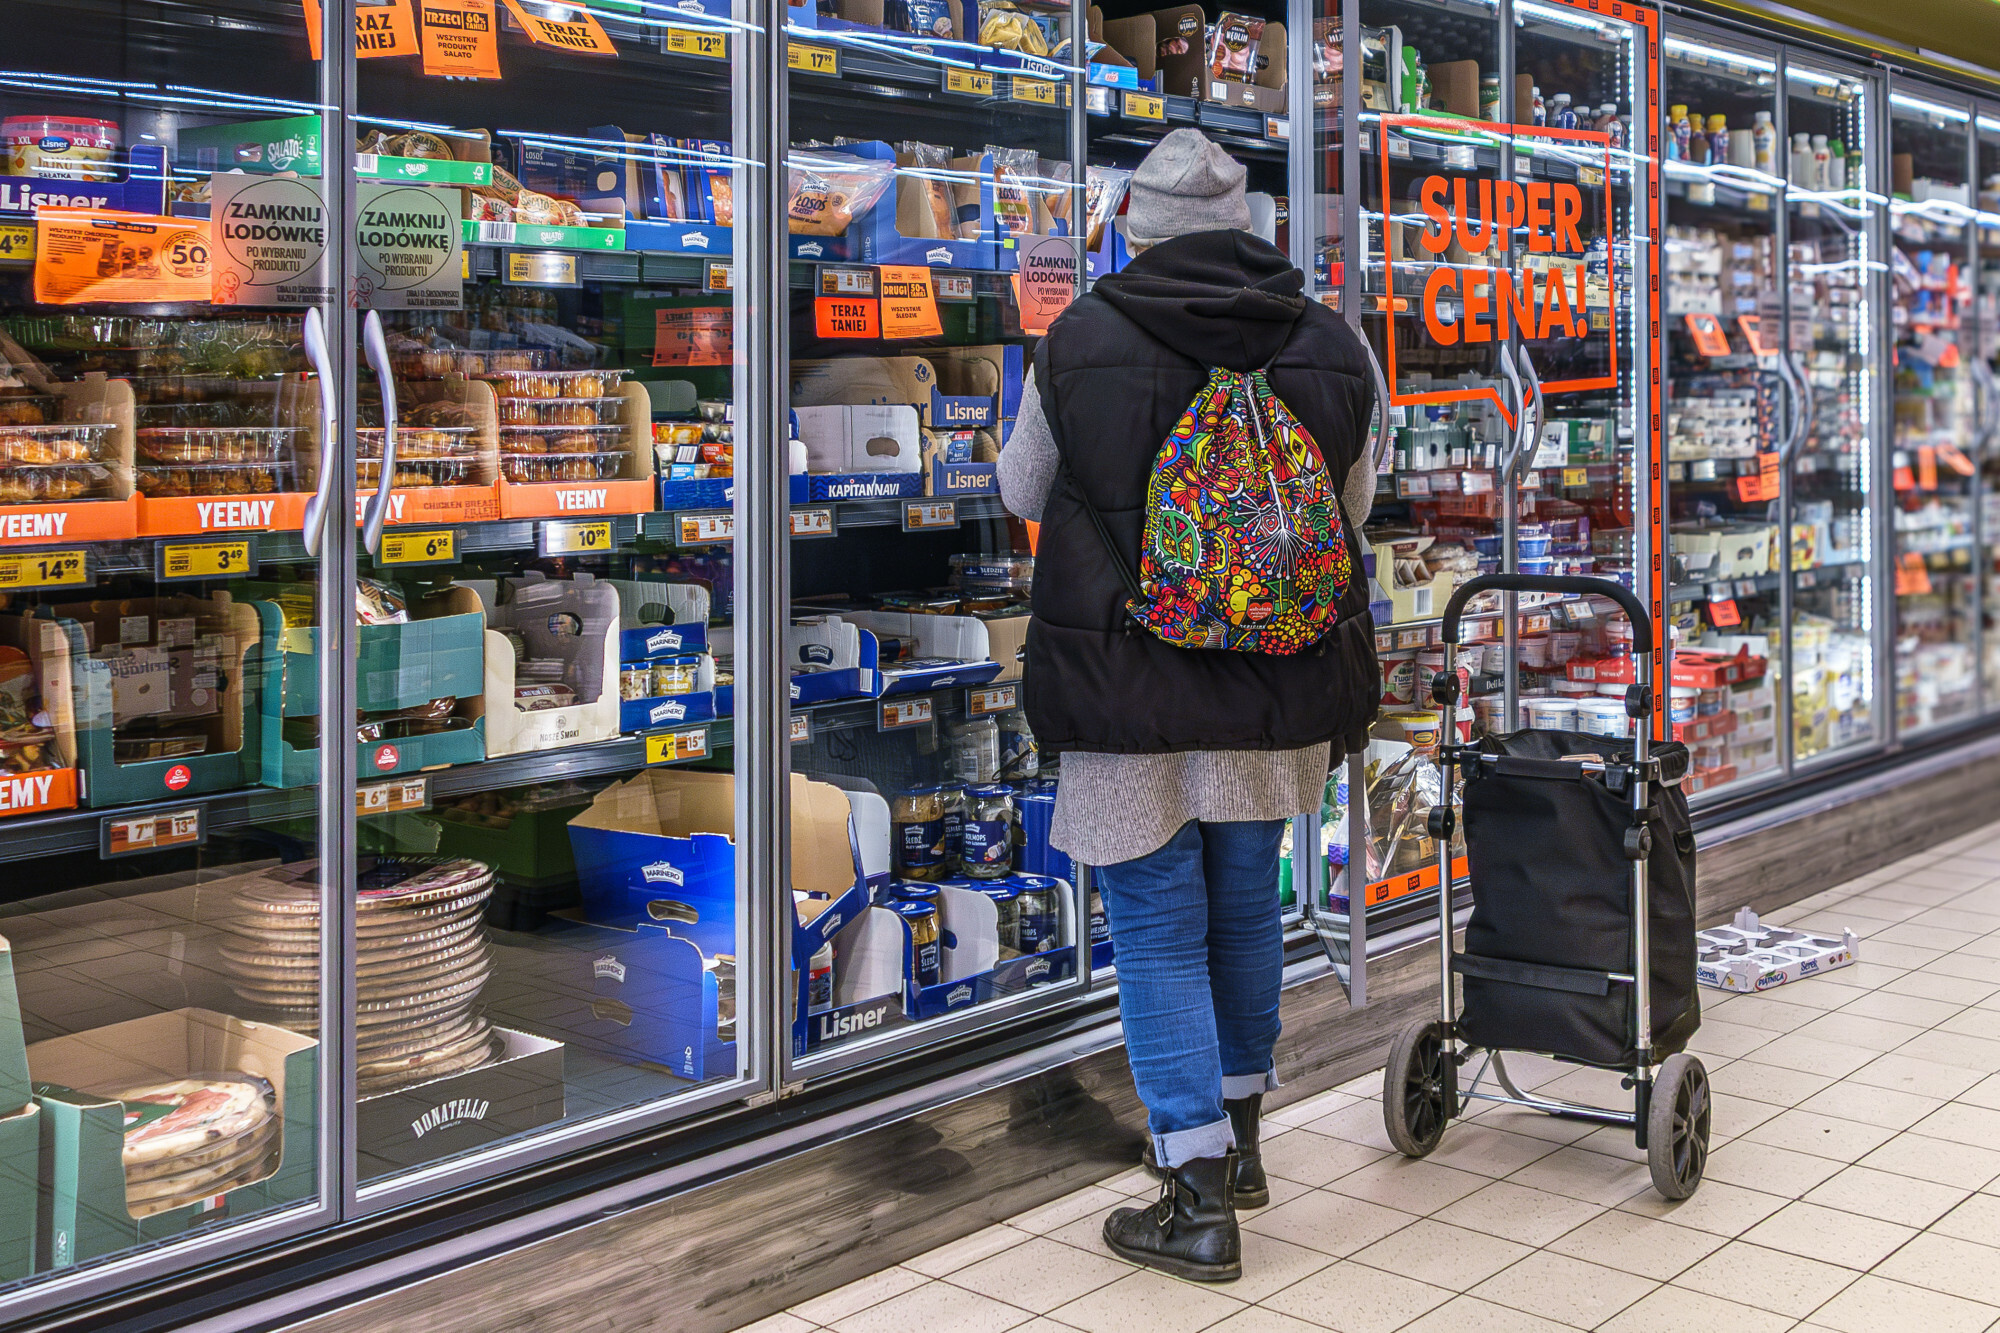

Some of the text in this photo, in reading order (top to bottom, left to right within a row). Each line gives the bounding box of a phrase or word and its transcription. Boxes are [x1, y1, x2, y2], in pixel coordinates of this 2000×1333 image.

[425, 11, 461, 26] TRZECI
[465, 12, 487, 24] 60%
[465, 21, 487, 31] TANIEJ
[535, 19, 592, 38] TERAZ
[436, 33, 478, 44] WSZYSTKIE
[544, 32, 598, 49] TANIEJ
[437, 41, 478, 51] PRODUKTY
[443, 50, 473, 59] SALATO
[1020, 57, 1055, 75] Lisner
[18, 136, 32, 145] XXL
[41, 139, 68, 149] Lisner
[73, 137, 90, 147] XXL
[267, 138, 300, 162] SALATO
[405, 163, 427, 174] SALATO
[0, 183, 109, 211] Lisner
[795, 195, 829, 212] ŁOSOŚ
[230, 202, 322, 223] ZAMKNIJ
[1420, 175, 1585, 254] SUPER
[363, 211, 446, 230] ZAMKNIJ
[225, 219, 325, 248] LODÓWKĘ
[541, 230, 564, 242] SALATO
[682, 235, 708, 246] MARINERO
[357, 229, 449, 253] LODÓWKĘ
[171, 244, 208, 265] 50
[246, 246, 307, 260] PO WYBRANIU
[378, 252, 433, 265] PO WYBRANIU
[928, 251, 951, 261] MARINERO
[252, 259, 300, 272] PRODUKTU
[1029, 256, 1077, 270] ZAMKNIJ
[384, 264, 428, 277] PRODUKTU
[1026, 269, 1079, 288] LODÓWKĘ
[883, 285, 908, 296] DRUGI
[910, 283, 925, 292] 50%
[830, 304, 866, 317] TERAZ
[891, 305, 921, 313] WSZYSTKIE
[1422, 264, 1587, 346] CENA!
[830, 318, 867, 332] TANIEJ
[945, 401, 988, 421] Lisner
[946, 470, 992, 489] Lisner
[423, 501, 462, 511] CHICKEN
[464, 499, 498, 509] BREAST
[555, 489, 607, 511] YEEMY
[197, 500, 275, 528] YEEMY
[650, 638, 679, 649] MARINERO
[653, 708, 683, 719] MARINERO
[645, 869, 680, 880] MARINERO
[1801, 957, 1818, 971] Serek
[1697, 966, 1717, 980] Serek
[820, 1005, 887, 1041] Lisner
[411, 1098, 490, 1139] DONATELLO
